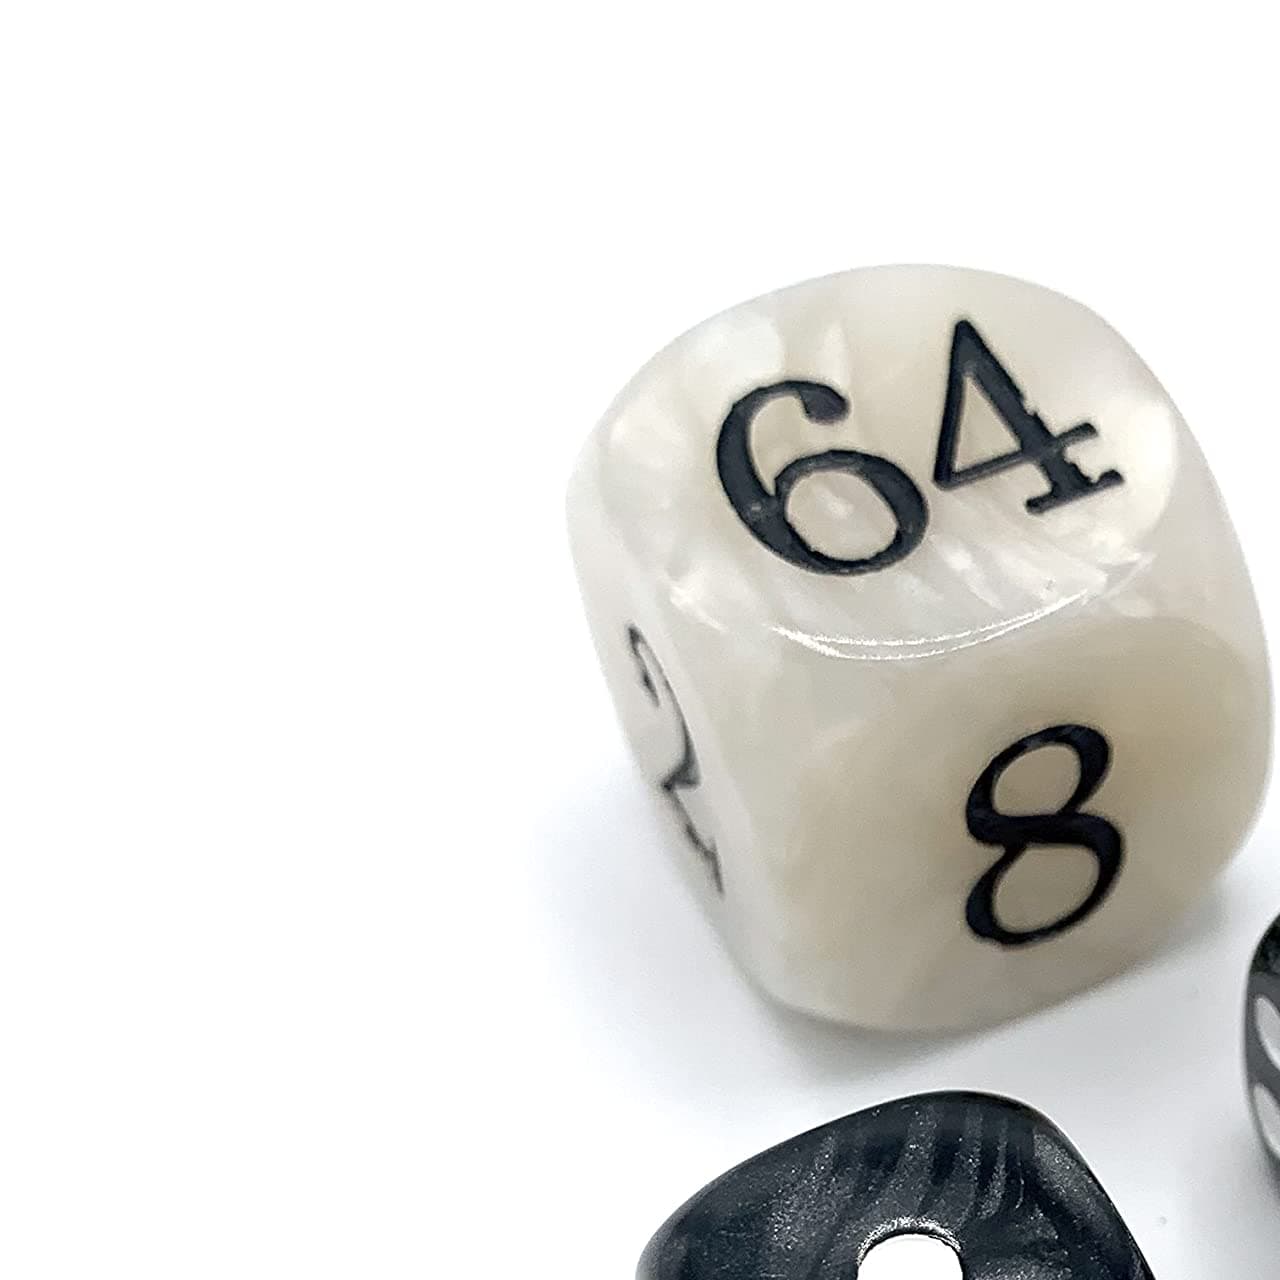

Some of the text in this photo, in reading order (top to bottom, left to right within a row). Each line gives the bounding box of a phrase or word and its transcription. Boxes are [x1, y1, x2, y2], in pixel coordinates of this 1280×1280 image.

[715, 319, 1125, 577] 64
[625, 622, 724, 895] 2
[962, 722, 1128, 953] 8
